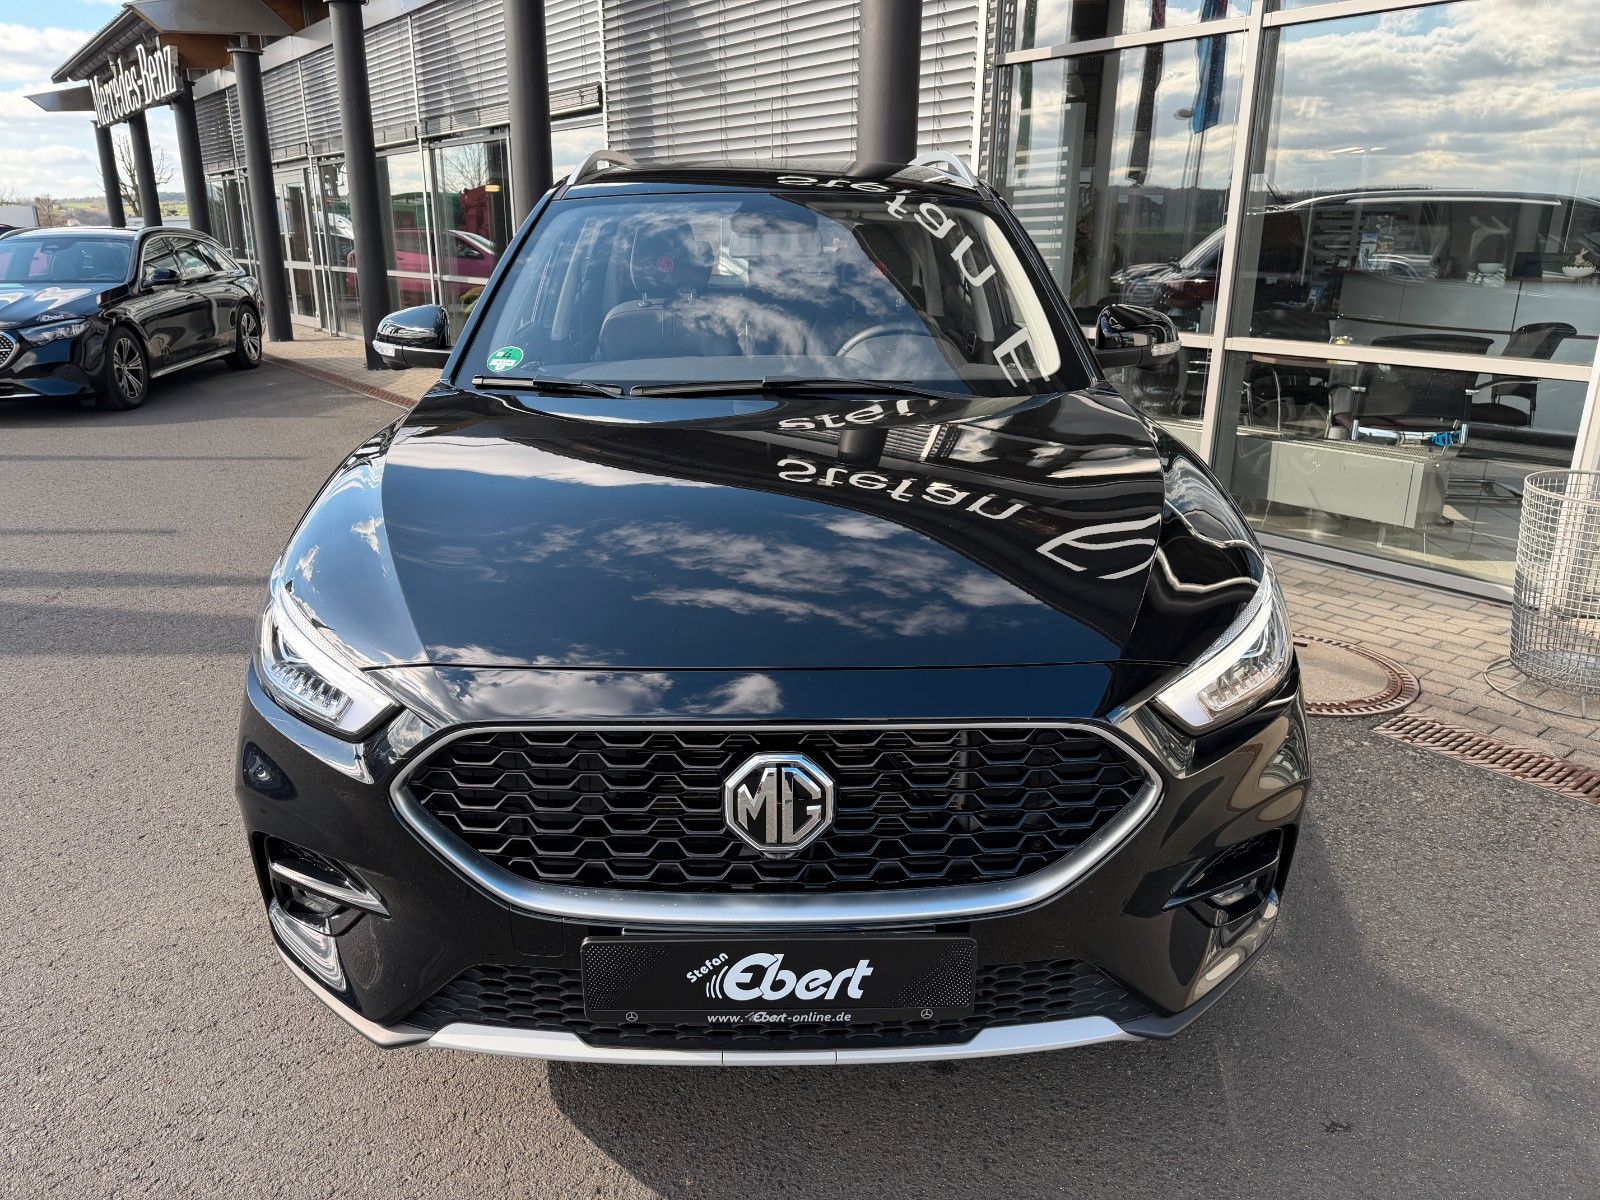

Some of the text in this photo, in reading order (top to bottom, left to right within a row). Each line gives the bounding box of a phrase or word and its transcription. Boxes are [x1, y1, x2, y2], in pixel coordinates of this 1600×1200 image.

[89, 44, 177, 128] Mercedes-Benz
[737, 767, 822, 844] MG
[686, 952, 873, 1001] Stefan Ebert
